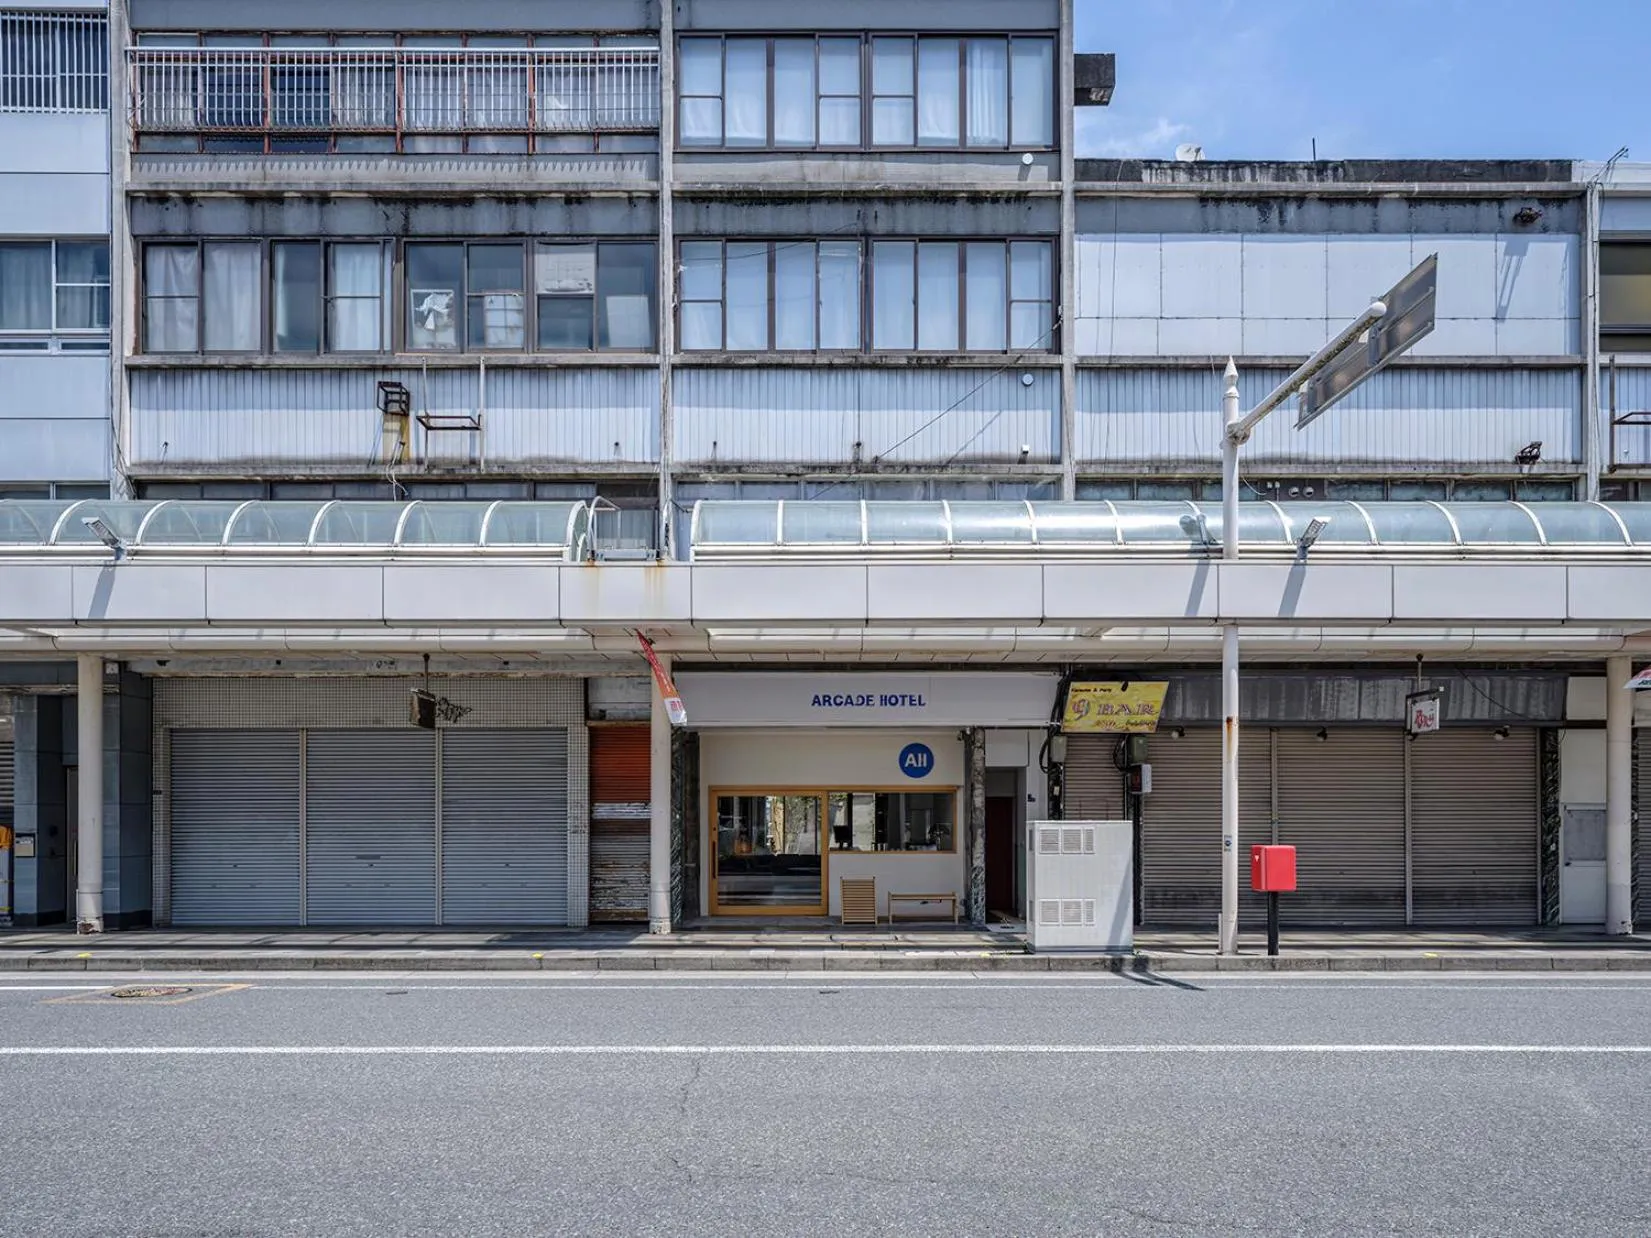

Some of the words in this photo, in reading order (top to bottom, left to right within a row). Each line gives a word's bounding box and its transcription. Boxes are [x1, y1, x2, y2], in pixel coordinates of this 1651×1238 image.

[811, 694, 875, 707] ARCADE
[880, 694, 926, 707] HOTEL
[1096, 703, 1155, 716] BAR
